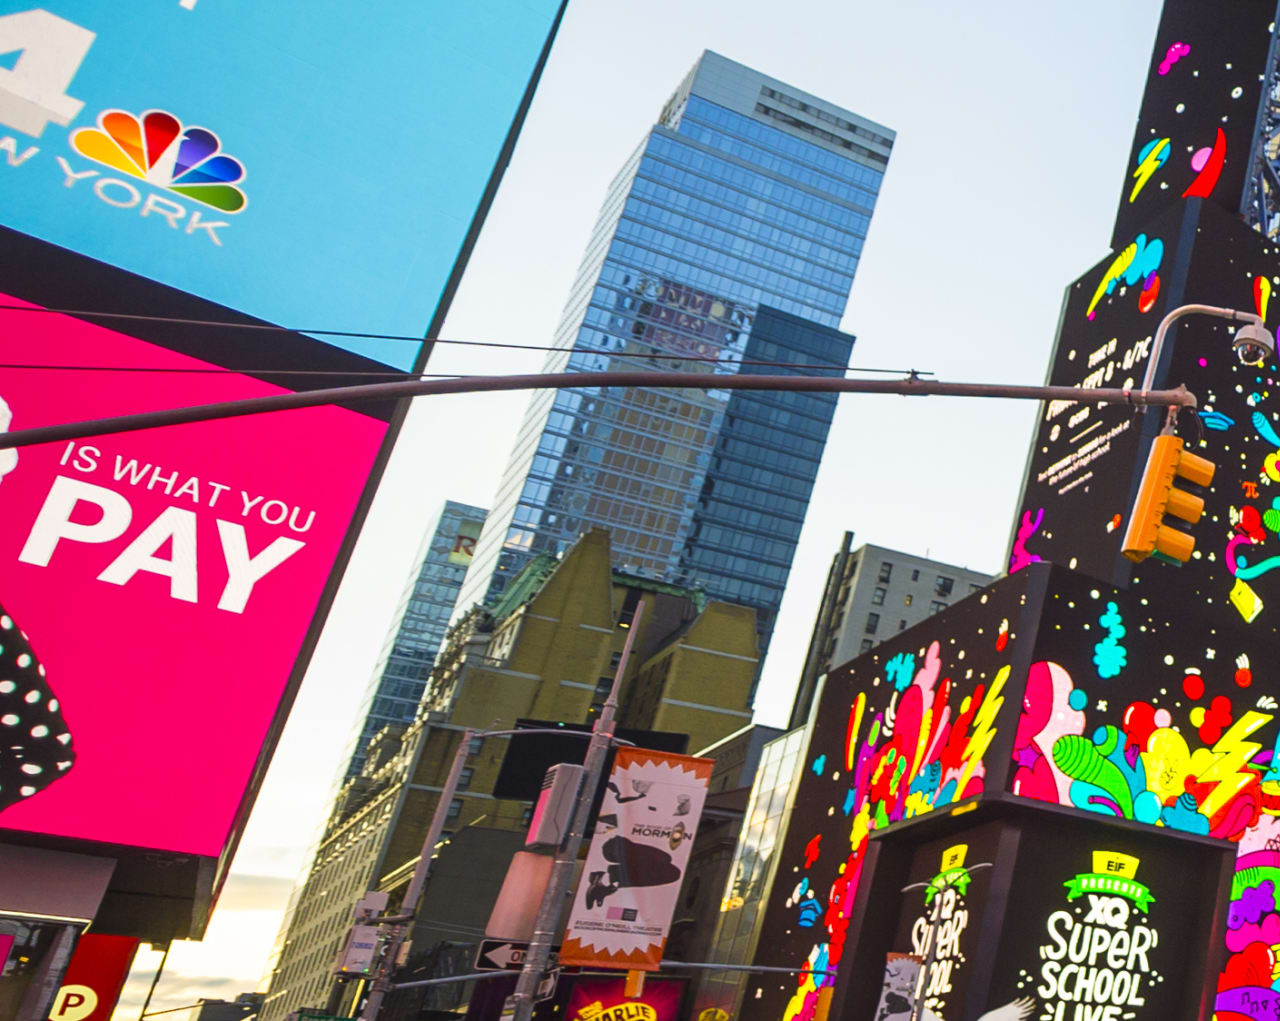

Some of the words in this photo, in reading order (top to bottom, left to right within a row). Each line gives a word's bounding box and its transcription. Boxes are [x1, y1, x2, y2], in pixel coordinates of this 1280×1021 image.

[59, 441, 102, 473] IS
[113, 455, 232, 508] WHAT
[240, 490, 317, 533] YOU
[17, 474, 307, 615] PAY
[1107, 860, 1126, 872] EIF
[1083, 893, 1131, 930] XQ
[1037, 960, 1146, 1007] SCHOOL
